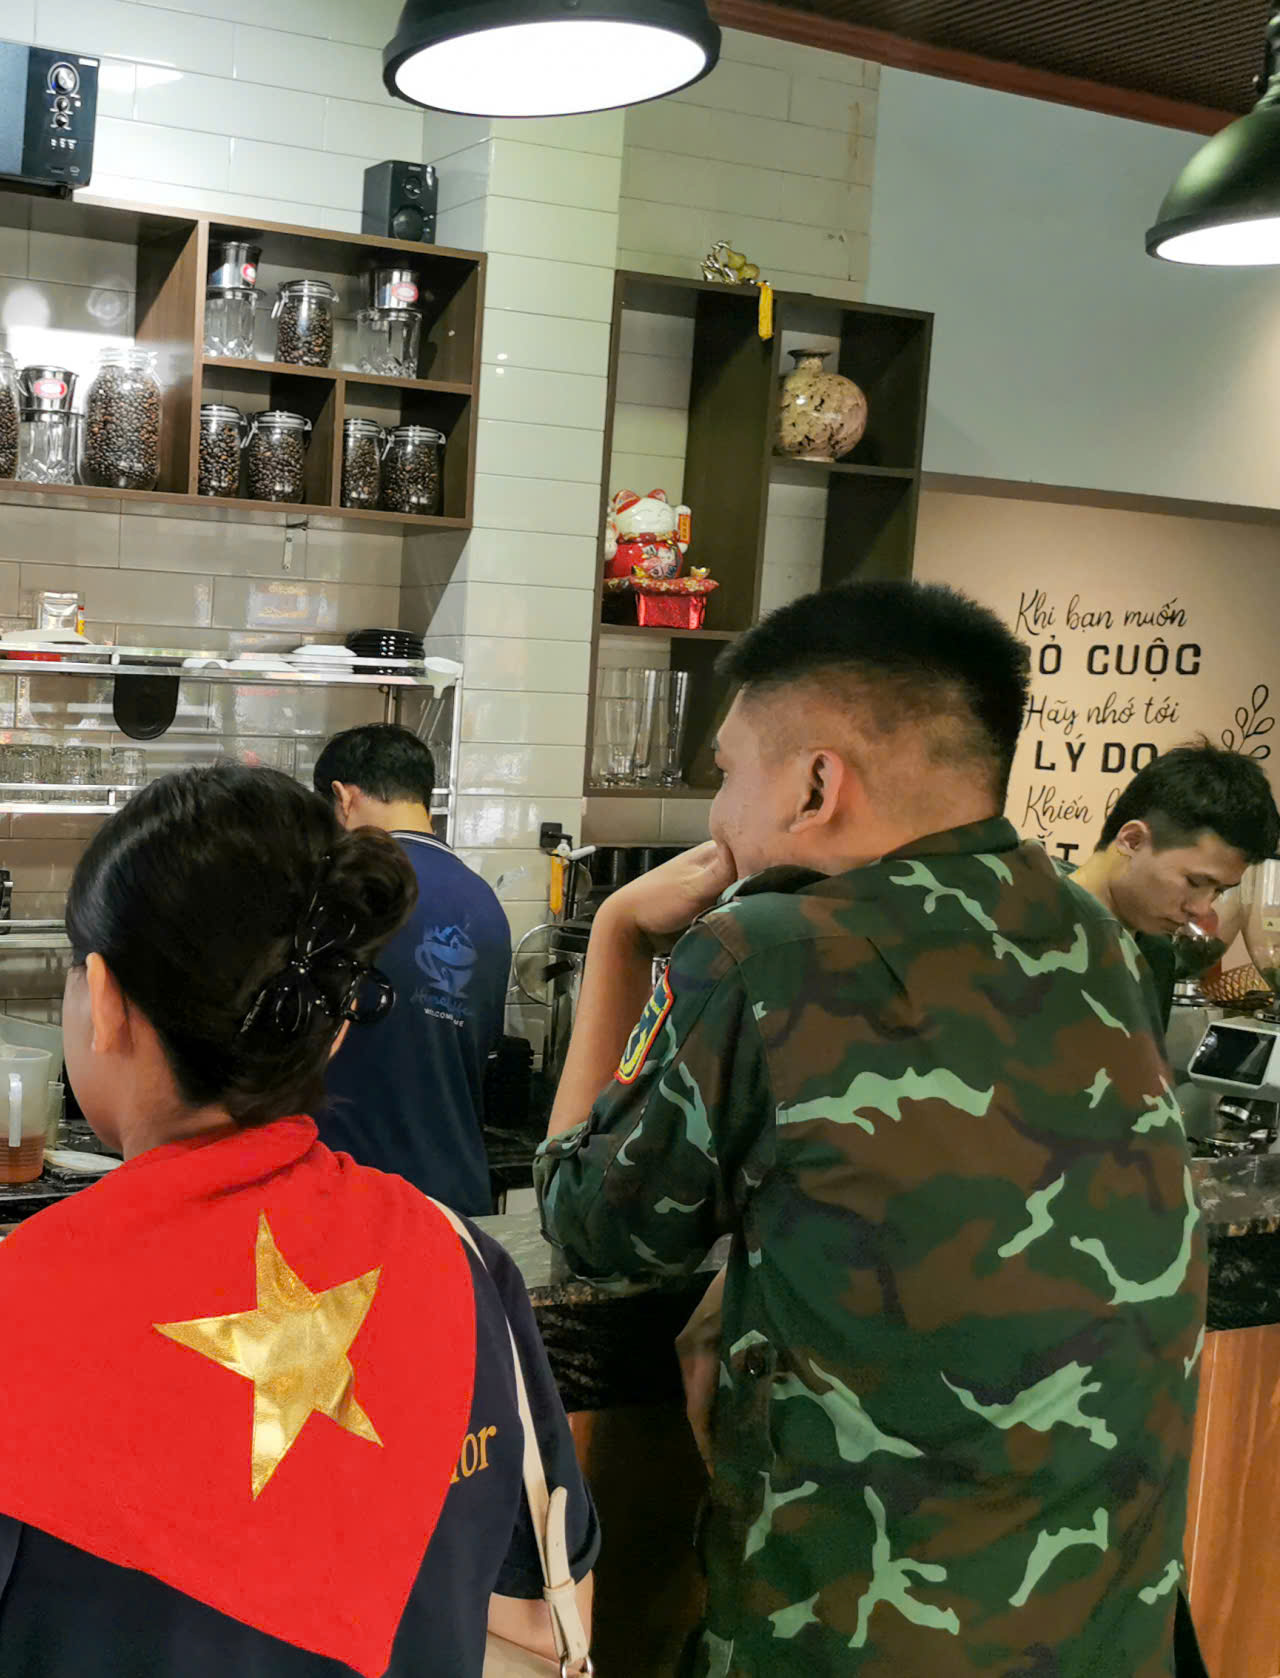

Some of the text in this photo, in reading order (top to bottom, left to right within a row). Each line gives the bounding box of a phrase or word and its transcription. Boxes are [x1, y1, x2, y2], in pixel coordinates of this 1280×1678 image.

[1015, 588, 1187, 635] Khi bạn muốn
[1086, 636, 1202, 682] CUỘC
[1023, 691, 1180, 735] Hãy nhớ tới
[1034, 733, 1158, 774] LÝ DO
[1021, 785, 1093, 831] Khiến
